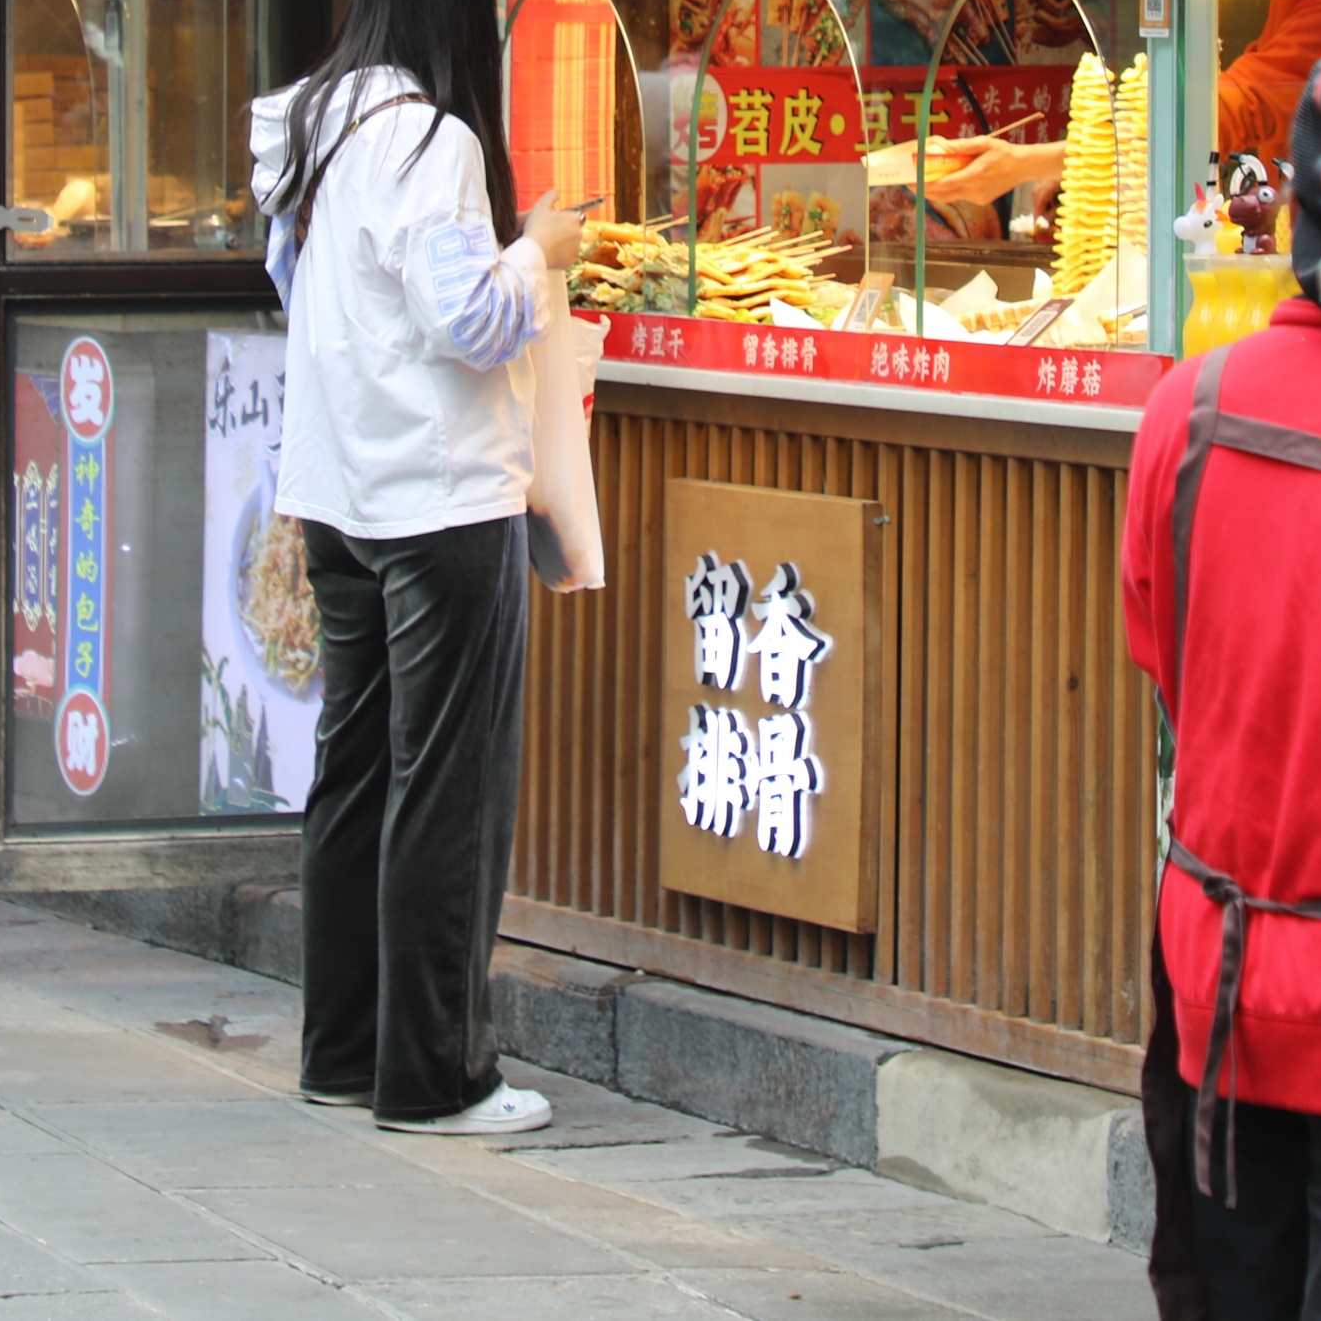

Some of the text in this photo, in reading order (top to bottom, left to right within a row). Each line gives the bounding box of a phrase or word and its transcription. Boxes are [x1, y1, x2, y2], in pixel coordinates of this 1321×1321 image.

[631, 325, 685, 361] 烤豆干
[742, 332, 818, 373] 留香排骨
[870, 340, 951, 384] 绝味炸肉
[1037, 356, 1103, 398] 炸蘑菇
[206, 356, 285, 452] 乐山
[684, 549, 834, 710] 留香
[676, 699, 825, 860] 排骨
